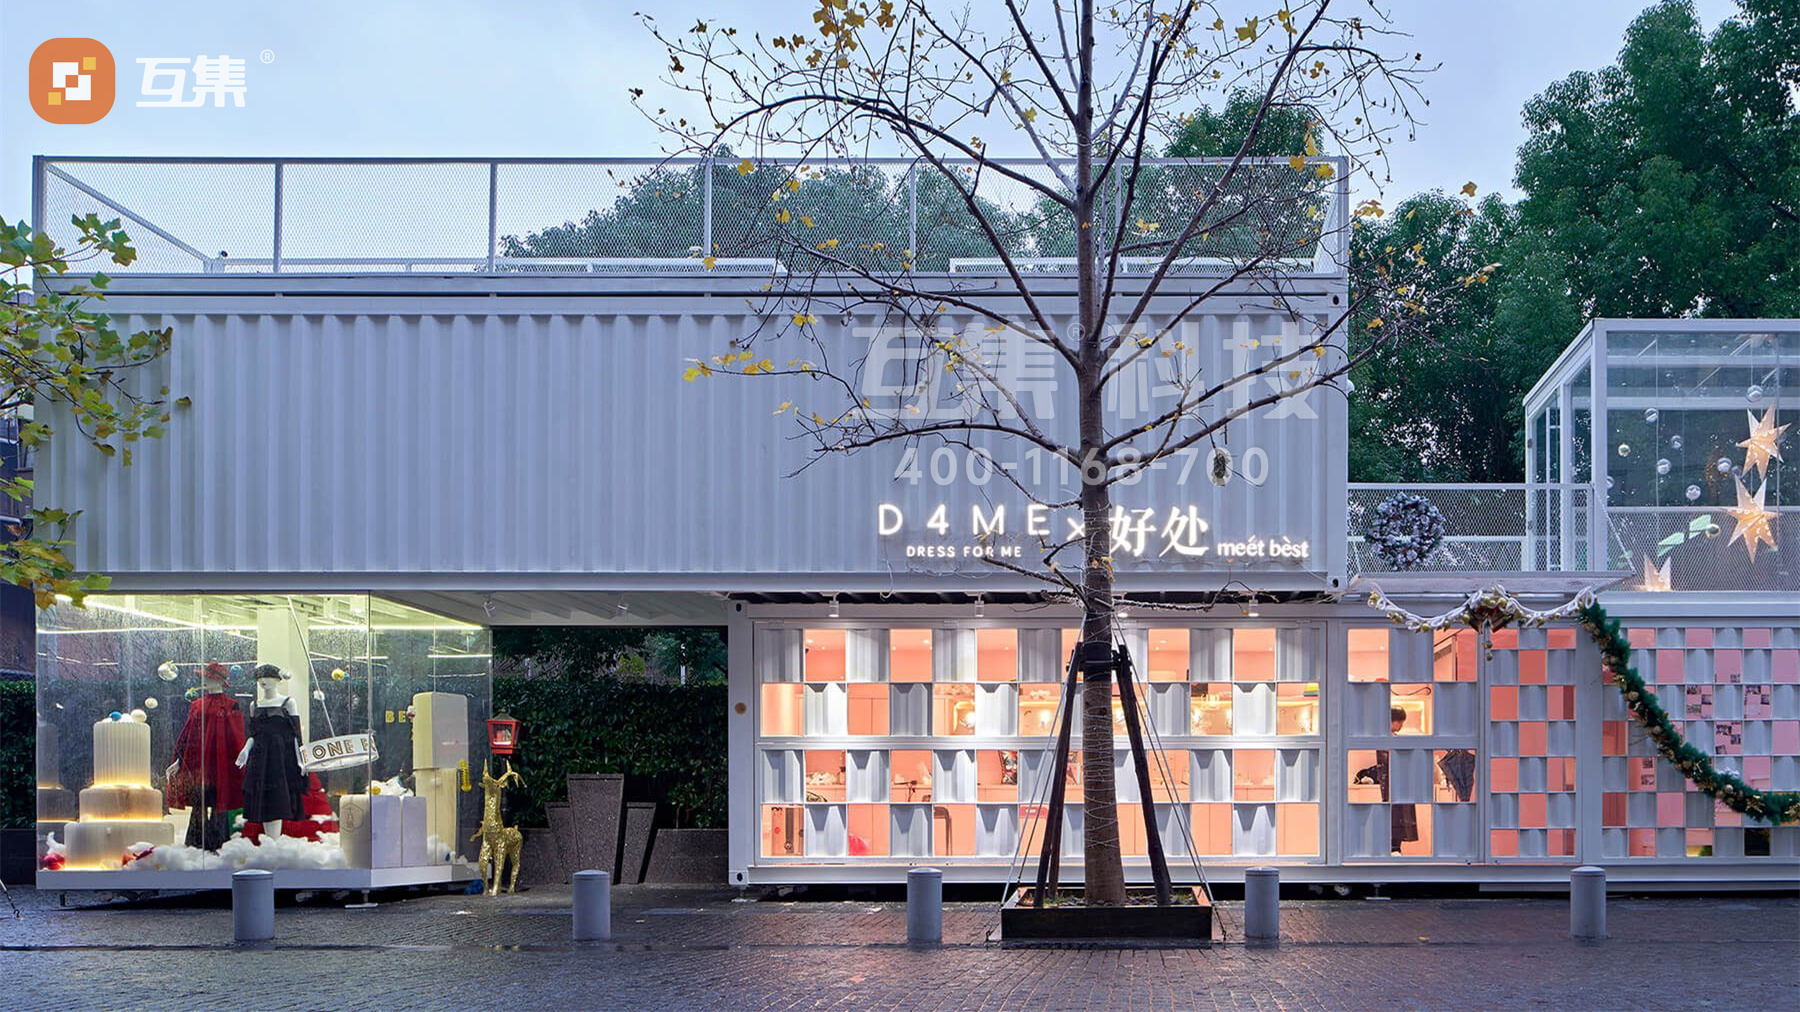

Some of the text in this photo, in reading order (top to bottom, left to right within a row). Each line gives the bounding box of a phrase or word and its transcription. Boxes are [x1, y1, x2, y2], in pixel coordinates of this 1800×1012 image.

[1109, 505, 1210, 558] 好处
[906, 545, 1022, 558] DRESS FOR ME
[312, 739, 354, 760] ONE
